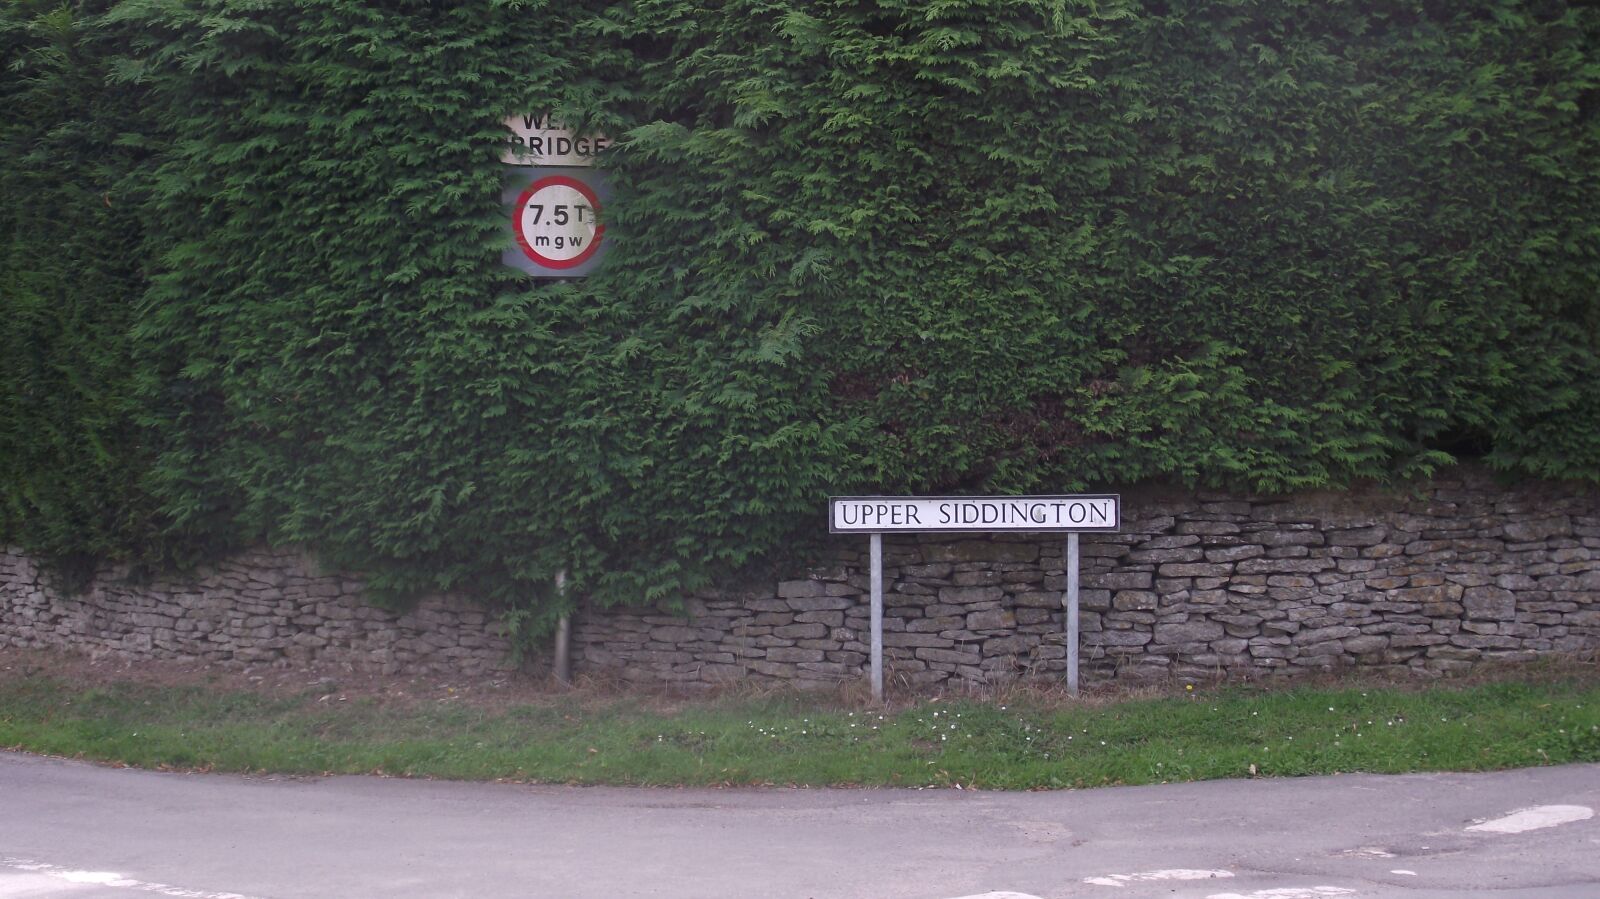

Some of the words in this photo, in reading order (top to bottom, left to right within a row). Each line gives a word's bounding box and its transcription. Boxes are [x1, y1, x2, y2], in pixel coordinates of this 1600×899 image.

[535, 236, 583, 249] mgw
[842, 504, 922, 525] UPPER
[939, 502, 1108, 524] SIDDINGTON
